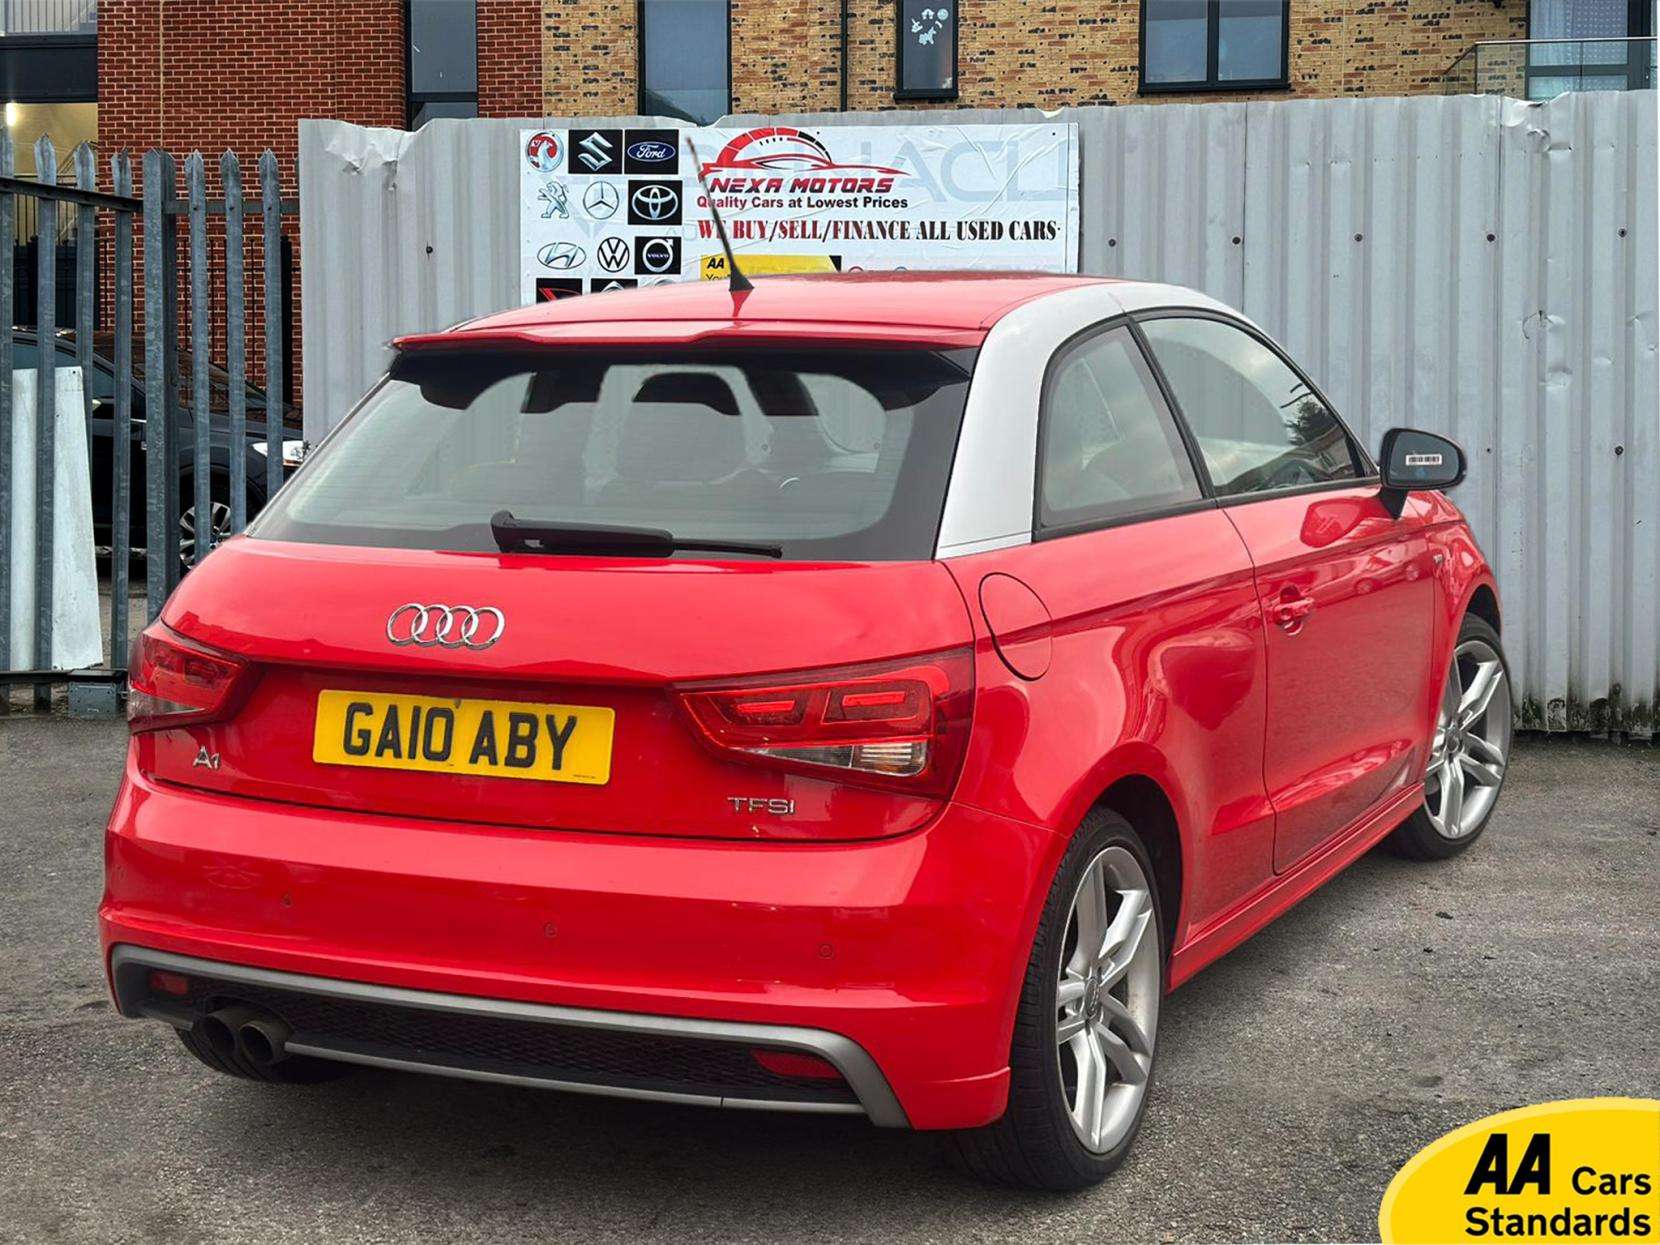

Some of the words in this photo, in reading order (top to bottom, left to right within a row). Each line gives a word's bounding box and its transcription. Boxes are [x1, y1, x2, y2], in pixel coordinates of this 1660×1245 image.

[636, 144, 666, 158] Ford
[710, 178, 783, 193] NEXA
[789, 178, 894, 193] MOTORS
[753, 197, 783, 208] Cars
[788, 197, 802, 208] at
[807, 196, 858, 208] Lowest
[863, 196, 908, 208] Prices
[733, 220, 910, 242] BUY/SELL/FINANCE
[916, 221, 950, 240] ALL
[957, 221, 1003, 240] USED
[1008, 221, 1057, 240] CARS
[706, 257, 724, 269] AA
[469, 711, 578, 770] ABY
[193, 745, 220, 769] A1
[727, 797, 795, 814] TFSI
